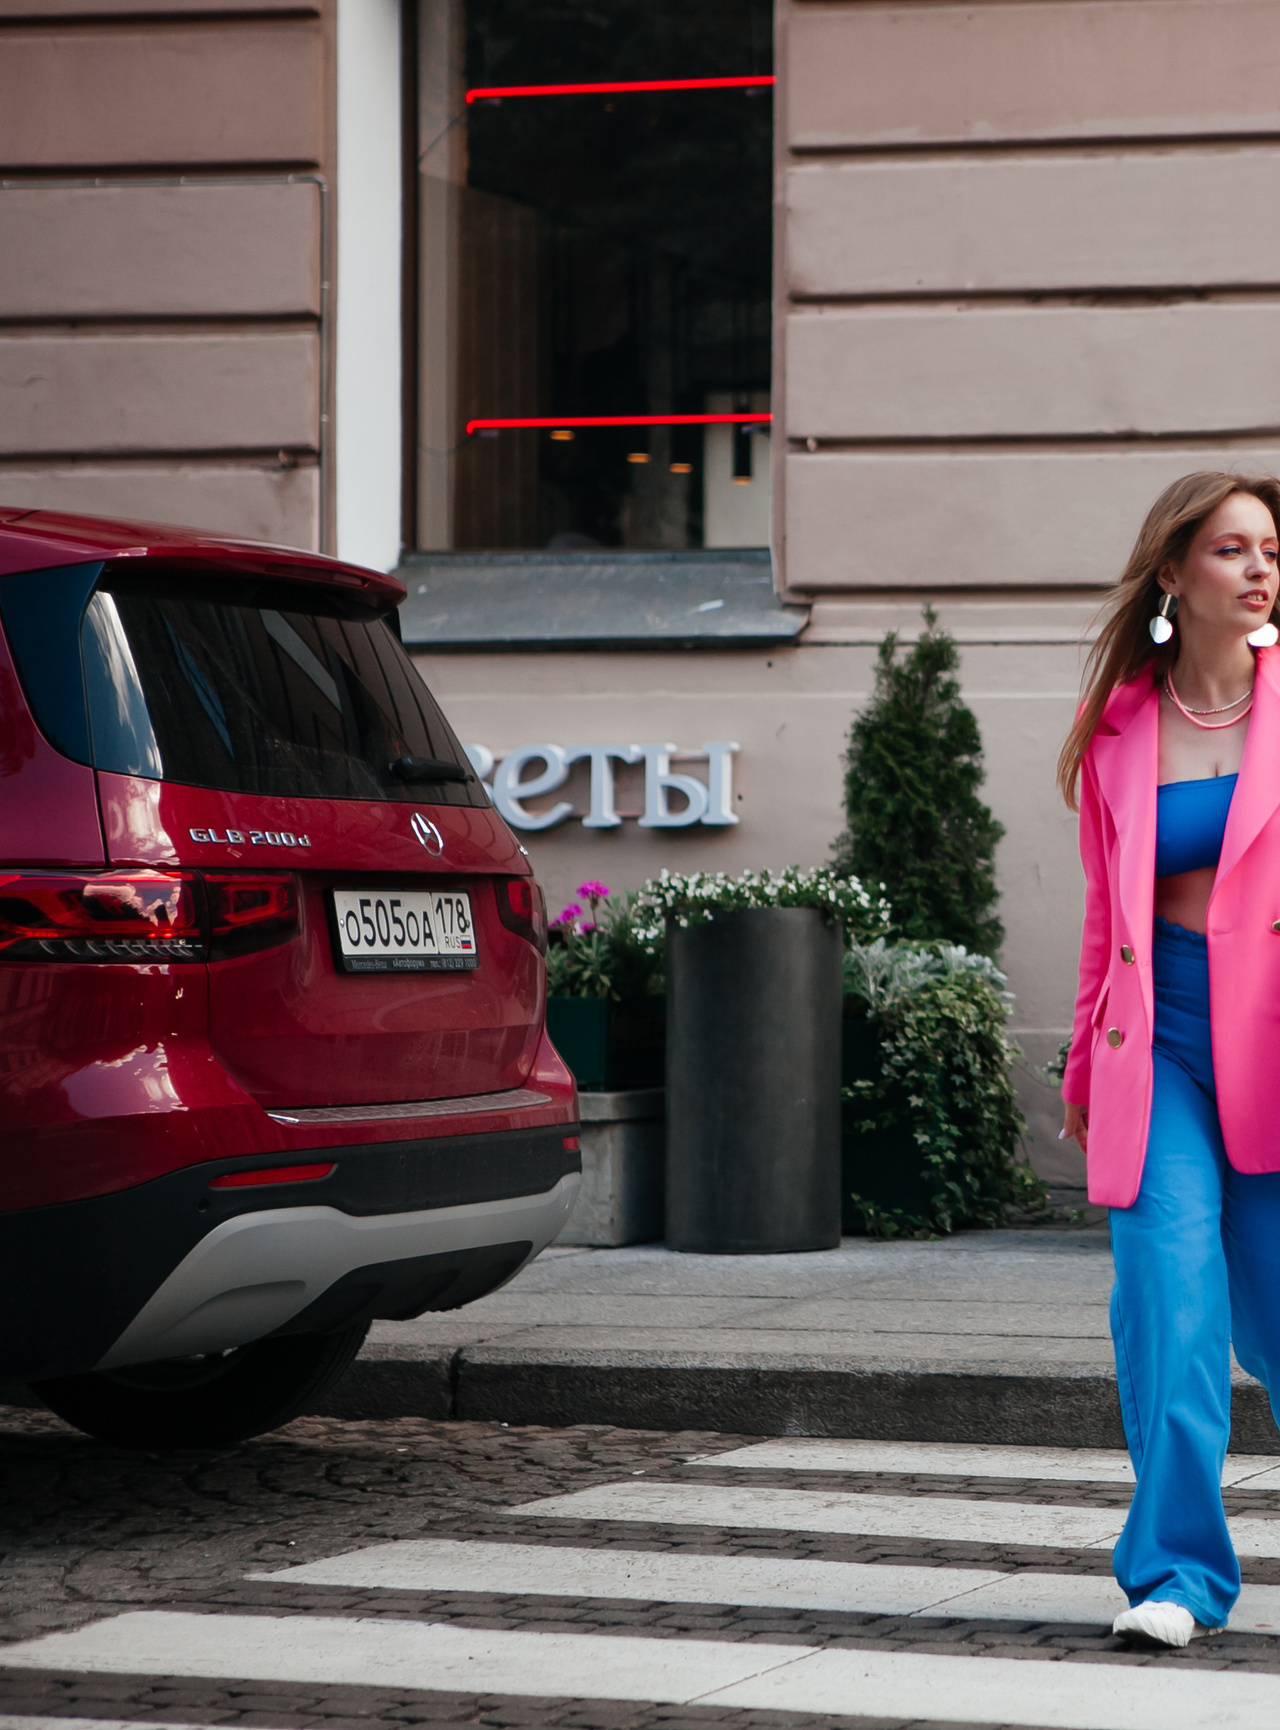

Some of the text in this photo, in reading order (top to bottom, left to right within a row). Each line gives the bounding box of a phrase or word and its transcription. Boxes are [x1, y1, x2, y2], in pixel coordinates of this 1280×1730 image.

[189, 828, 245, 844] GLB
[435, 898, 466, 934] 178
[444, 936, 461, 949] RUS
